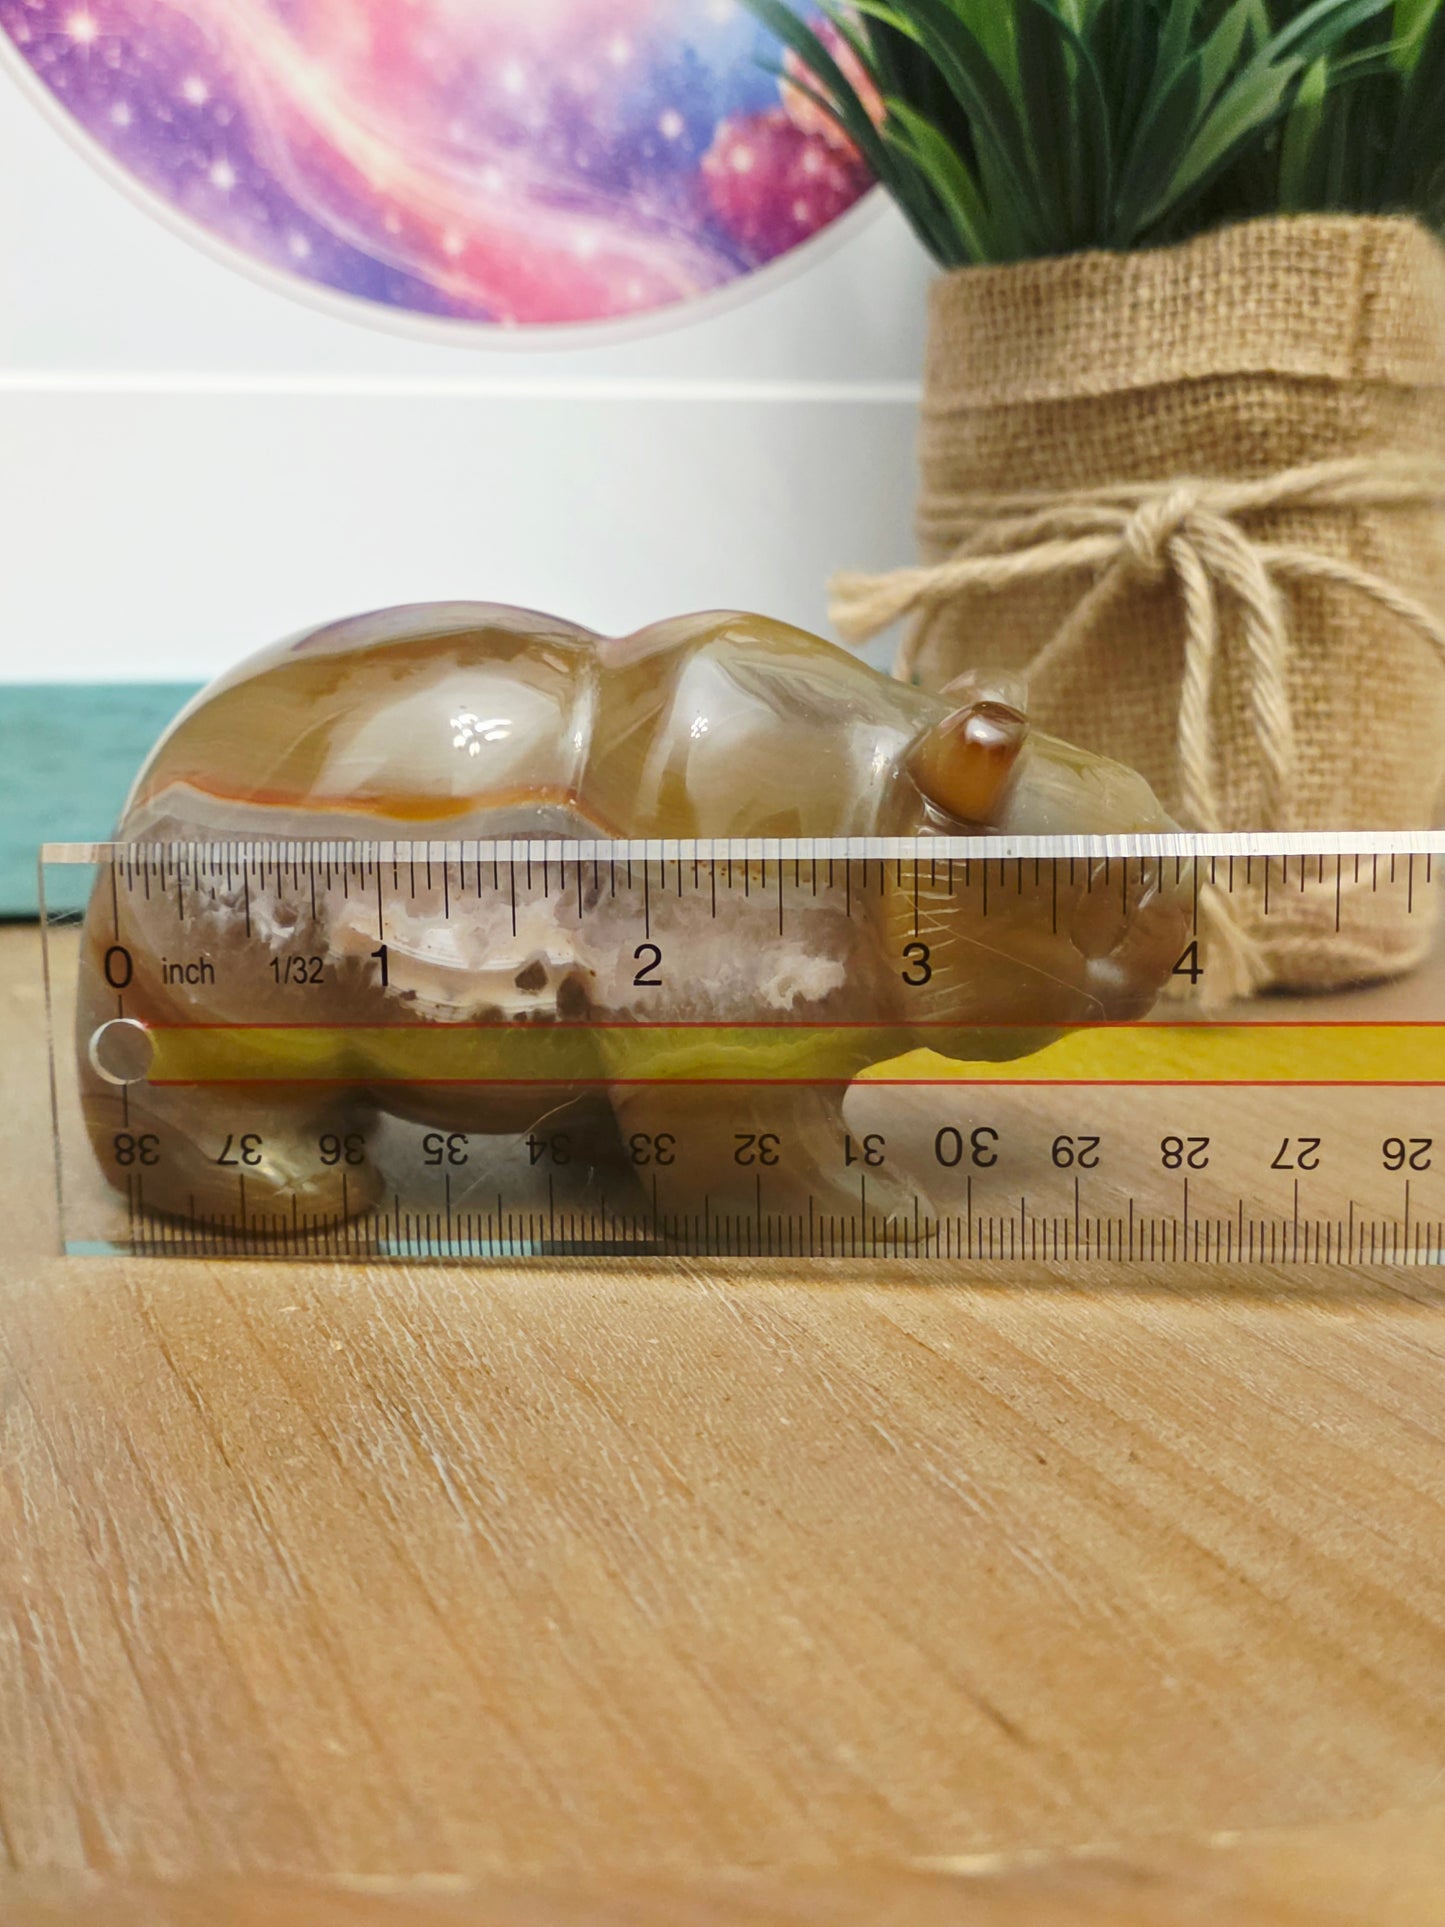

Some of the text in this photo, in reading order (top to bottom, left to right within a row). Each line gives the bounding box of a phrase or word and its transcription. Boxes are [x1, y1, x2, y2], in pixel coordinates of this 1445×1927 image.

[104, 941, 1204, 988] 0 inch 1/32 1 2 3 4
[114, 1126, 1432, 1171] 26 27 28 29 30 31 32 33 34 35 36 37 38
